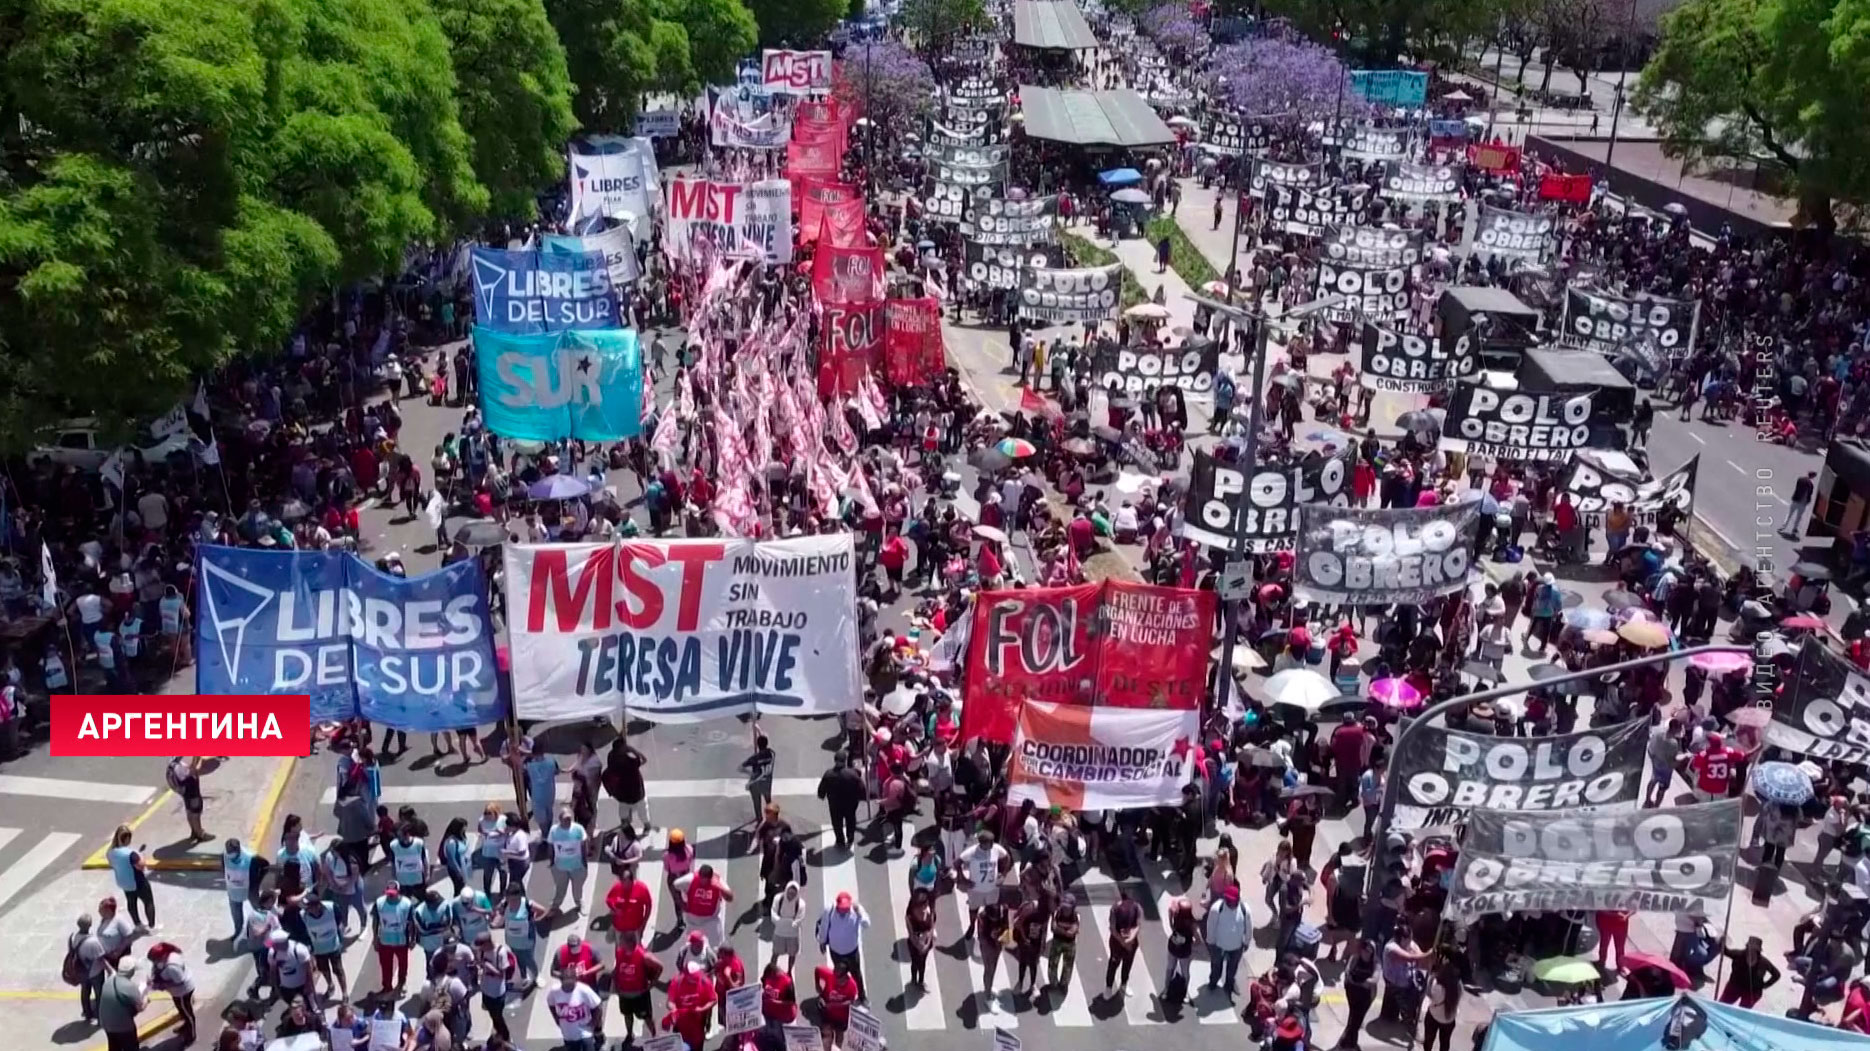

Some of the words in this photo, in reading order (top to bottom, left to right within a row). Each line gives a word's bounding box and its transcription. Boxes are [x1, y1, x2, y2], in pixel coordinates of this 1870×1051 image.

[764, 51, 824, 86] MST
[591, 175, 641, 193] LIBRES
[1260, 163, 1311, 182] POLO
[1389, 176, 1456, 194] OBRERO
[671, 179, 742, 224] MST
[1294, 207, 1367, 226] OBRERO
[1494, 215, 1551, 234] POLO
[1339, 226, 1409, 250] POLO
[1481, 229, 1552, 249] OBRERO
[508, 267, 610, 299] LIBRES
[1036, 271, 1109, 294] POLO
[1319, 263, 1405, 296] POLO
[508, 299, 555, 323] DEL
[560, 297, 611, 323] SUR
[1023, 288, 1115, 308] OBRERO
[1589, 296, 1671, 327] POLO
[825, 308, 880, 355] FOL
[1377, 329, 1470, 360] POLO
[1118, 349, 1201, 376] POLO
[1371, 353, 1473, 379] OBRERO
[496, 348, 604, 410] SUR
[1468, 387, 1592, 426] POLO
[1460, 417, 1589, 448] OBRERO
[1466, 442, 1521, 460] BARRIO
[1213, 458, 1345, 508] POLO
[1328, 519, 1457, 554] POLO
[732, 551, 850, 578] MOVIMIENTO
[1308, 547, 1468, 589] OBRERO
[526, 543, 726, 634] MST
[728, 583, 759, 602] SIN
[1112, 590, 1165, 612] FRENTE
[1168, 600, 1183, 614] DE
[275, 587, 483, 651] LIBRES
[725, 610, 808, 630] TRABAJO
[1098, 603, 1200, 630] ORGANIZACIONES
[984, 598, 1086, 678] FOL
[1109, 620, 1127, 641] EN
[1130, 625, 1177, 646] LUCHA
[273, 643, 371, 689] DEL
[378, 649, 483, 695] SUR
[575, 631, 701, 703] TERESA
[717, 628, 801, 693] VIVE
[1039, 760, 1117, 782] CAMBIO
[1119, 760, 1183, 782] SOCIAL
[1443, 733, 1606, 782] POLO
[1707, 763, 1728, 780] 33
[1407, 771, 1625, 810] OBRERO
[1502, 813, 1686, 860] POLO
[555, 1002, 589, 1023] MST
